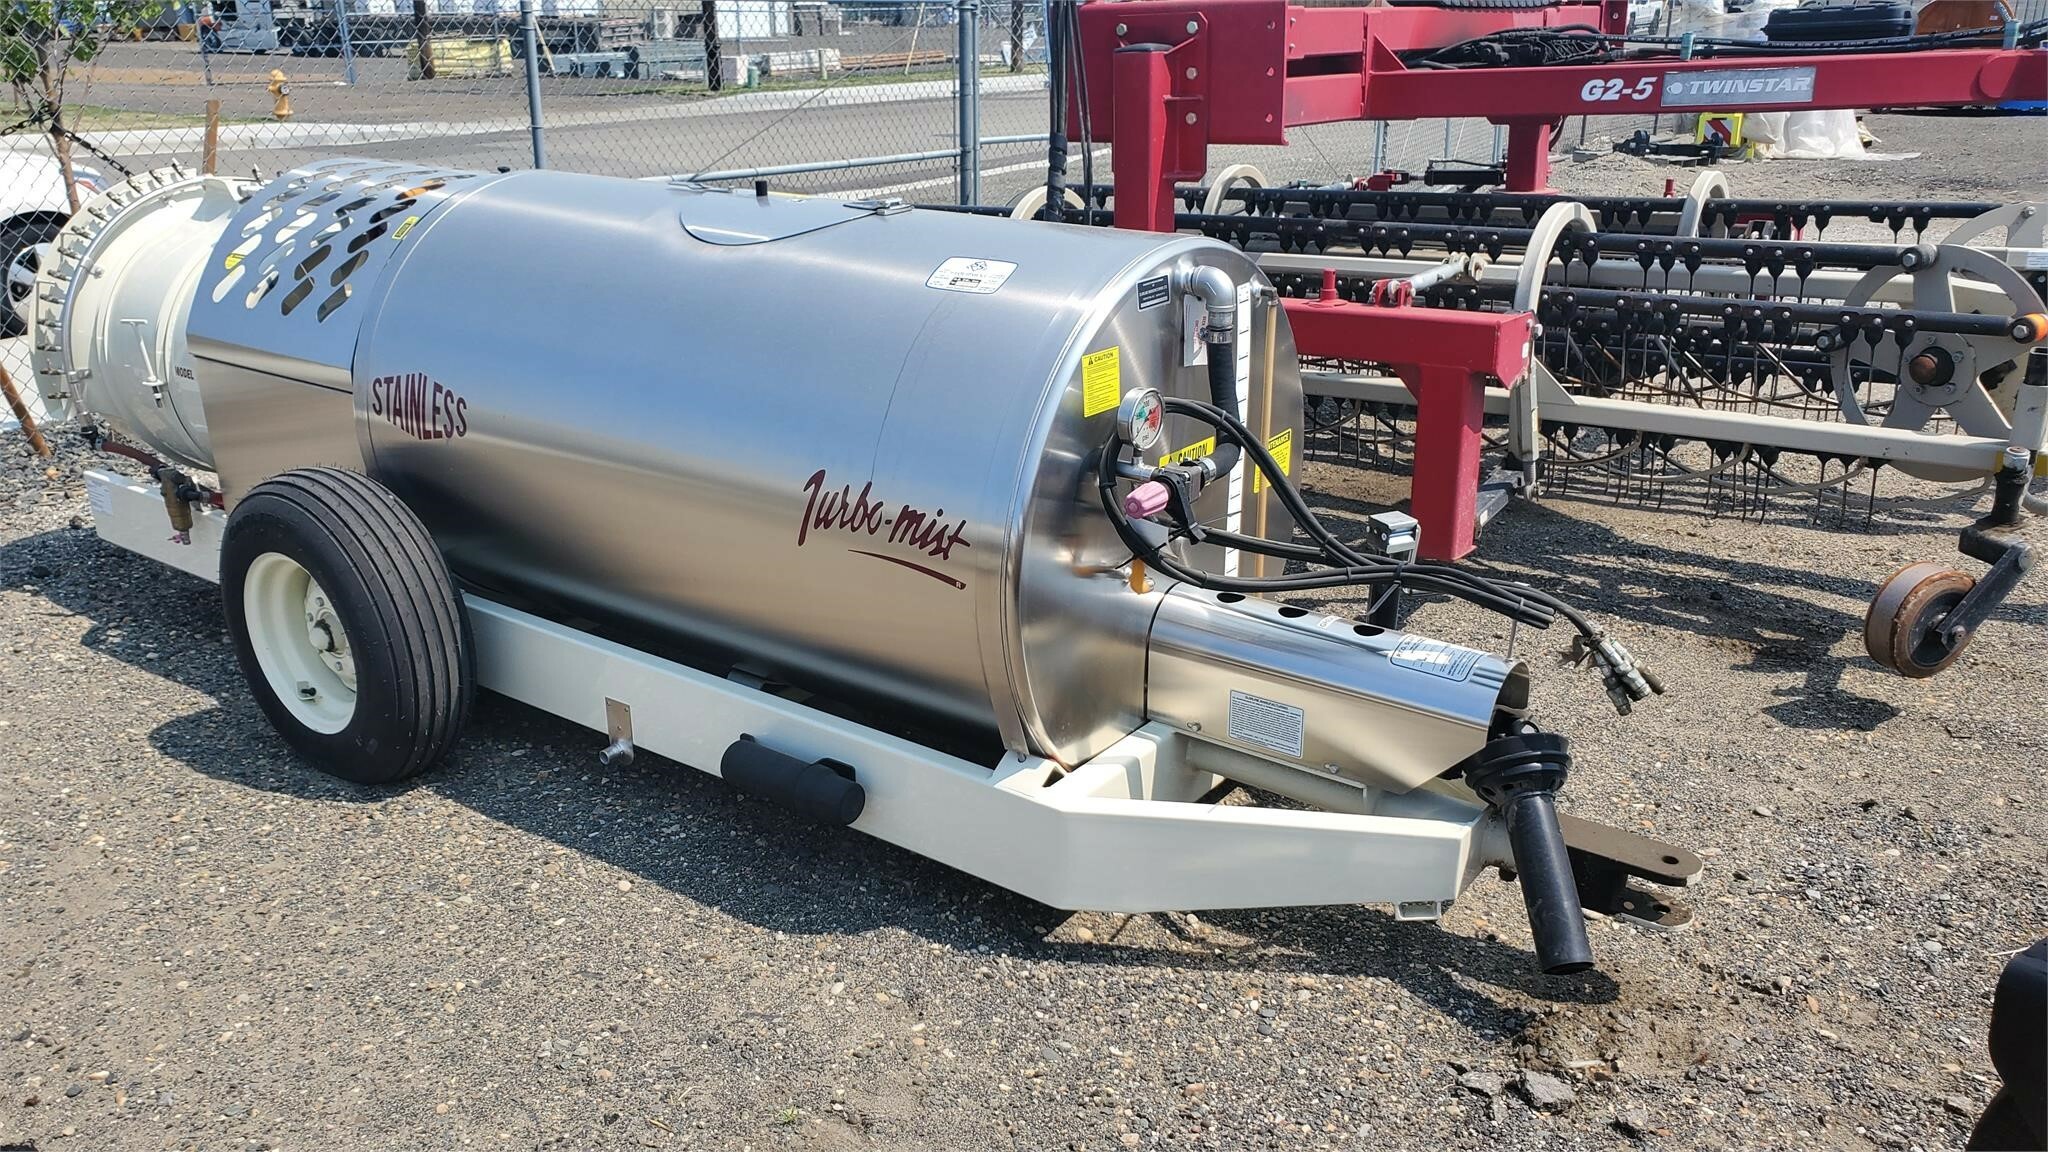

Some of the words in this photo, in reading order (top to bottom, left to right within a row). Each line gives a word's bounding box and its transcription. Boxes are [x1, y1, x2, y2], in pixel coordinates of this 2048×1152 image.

[1581, 77, 1657, 101] G2-5
[1689, 77, 1810, 95] TWINSTAR
[1093, 352, 1114, 363] CAUTION
[175, 366, 194, 380] MODEL
[372, 372, 467, 440] STAINLESS
